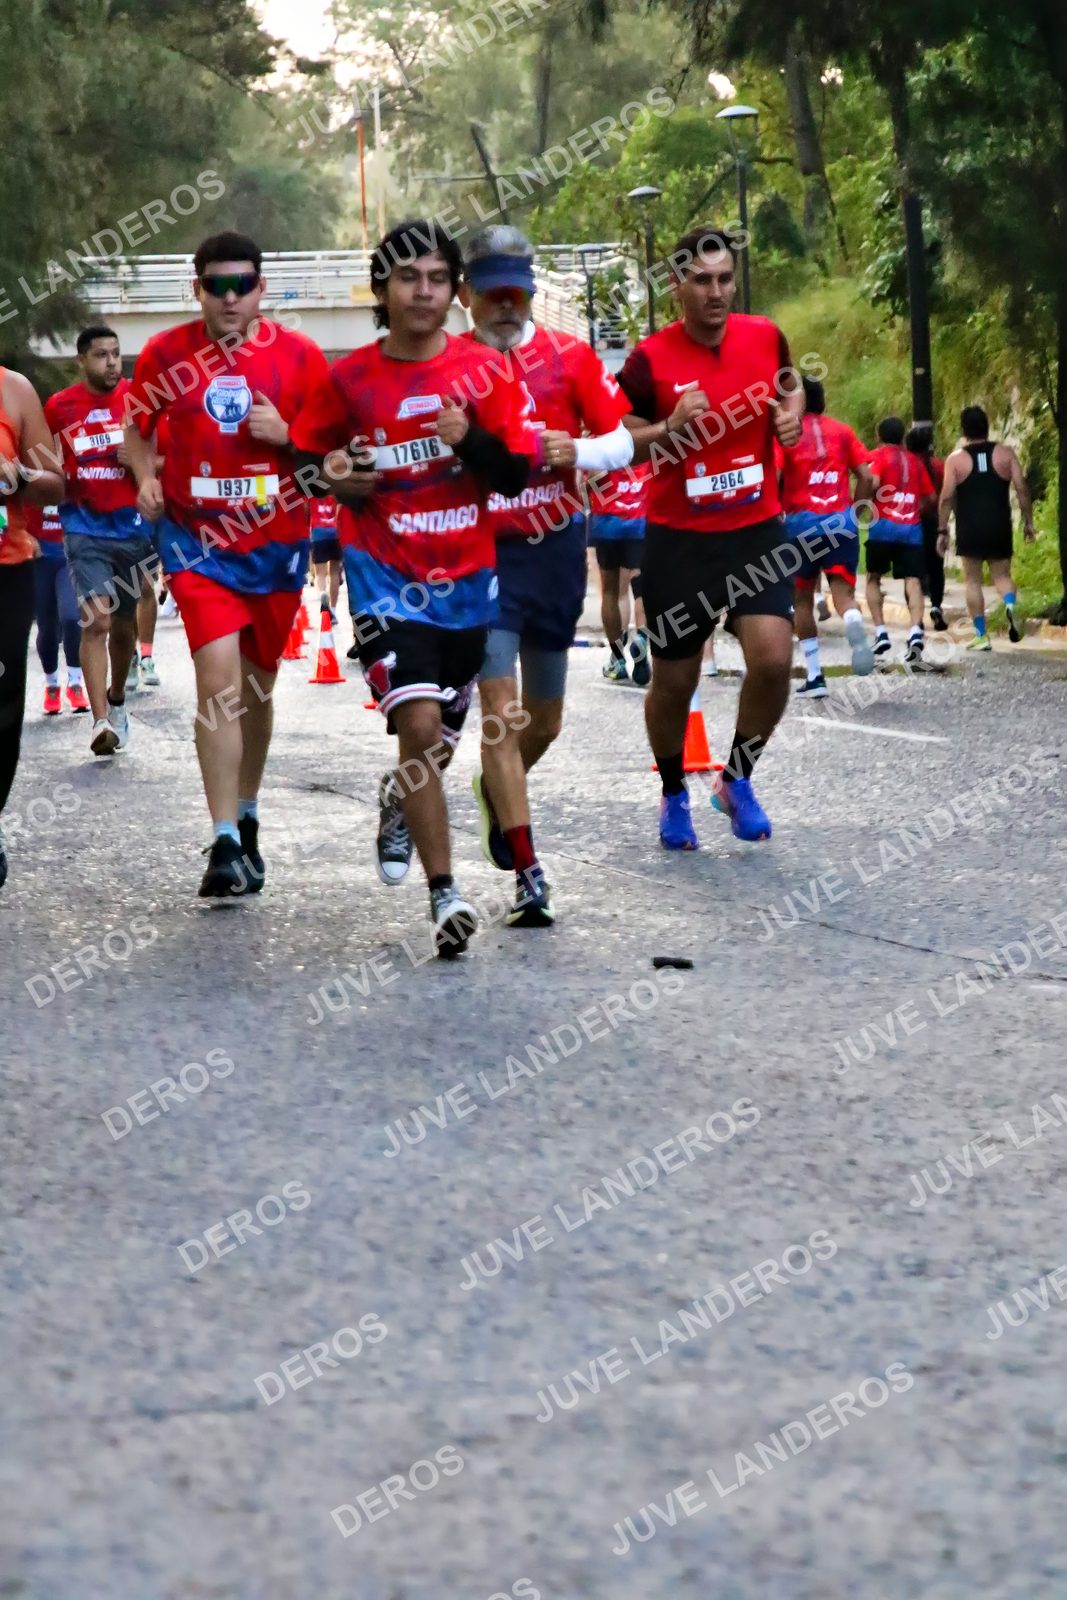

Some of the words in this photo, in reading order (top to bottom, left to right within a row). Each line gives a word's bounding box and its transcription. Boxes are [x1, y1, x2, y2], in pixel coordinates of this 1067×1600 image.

[89, 433, 112, 447] 3169
[391, 437, 441, 466] 17616
[76, 466, 126, 479] SANTIAGO
[711, 470, 745, 492] 2964
[215, 478, 252, 497] 1937
[388, 504, 480, 534] SANTIAGO
